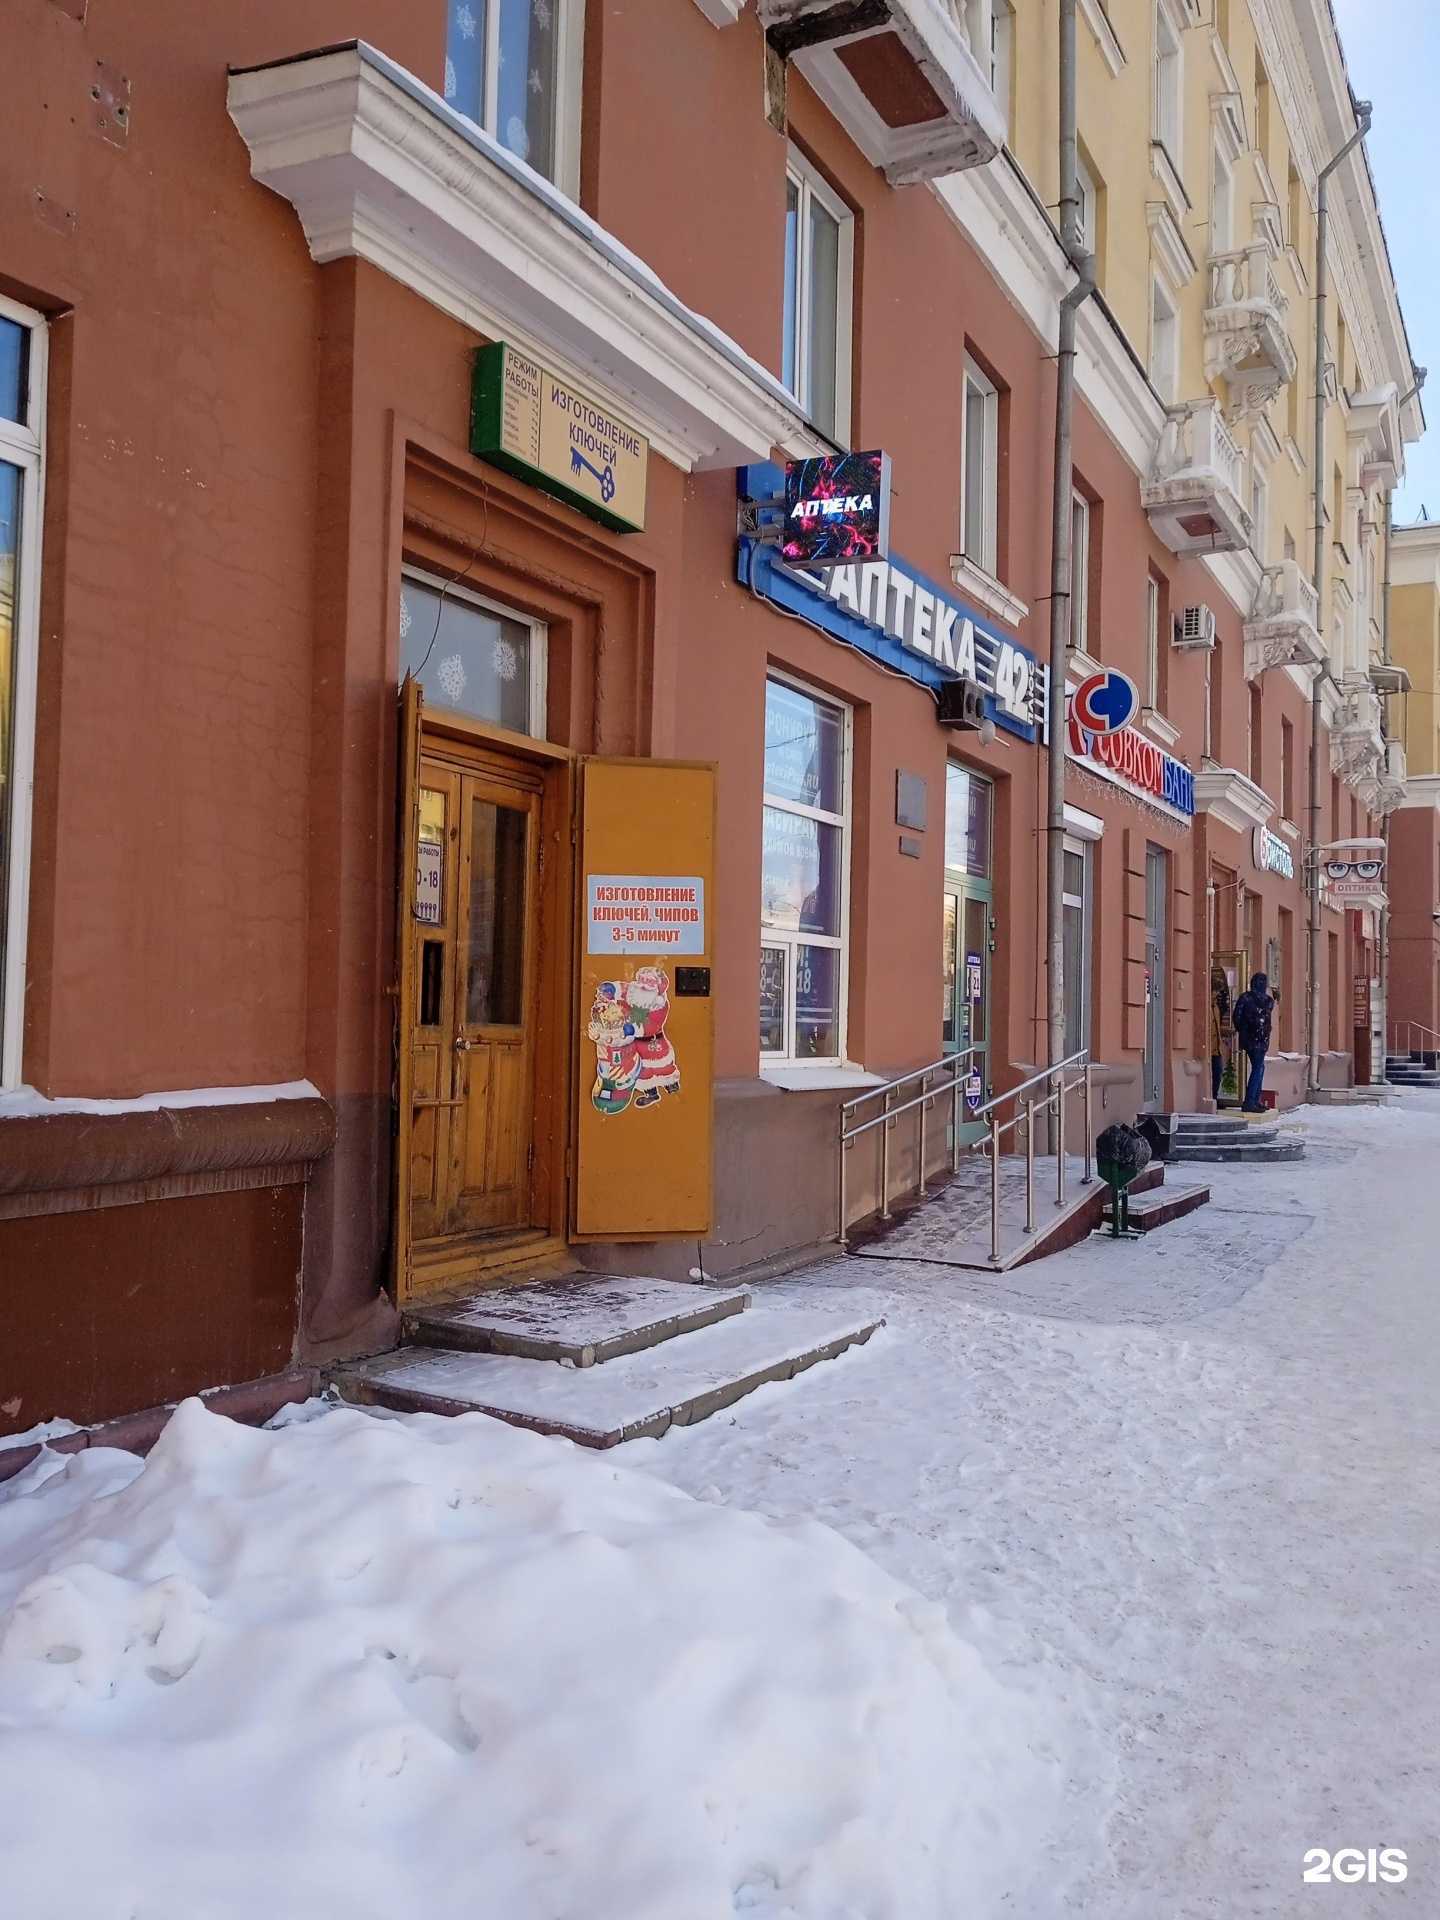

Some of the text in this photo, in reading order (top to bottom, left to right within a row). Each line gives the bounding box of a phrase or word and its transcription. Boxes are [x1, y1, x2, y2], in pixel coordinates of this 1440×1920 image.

[508, 353, 537, 381] РЕЖИМ
[505, 368, 539, 398] РАБОТЫ
[551, 385, 640, 457] ИЗГОТОВЛЕНИЕ
[569, 422, 617, 467] КЛЮЧЕЙ
[790, 494, 873, 518] АПТЕКА
[828, 561, 977, 682] АПТЕКА
[996, 641, 1029, 725] 42
[428, 870, 438, 888] 18
[1337, 884, 1378, 892] ОПТИКА
[596, 886, 696, 902] ИЗГОТОВЛЕНИЕ
[593, 905, 699, 922] КЛЮЧЕЙ, ЧИПОВ
[612, 927, 634, 941] 3-5
